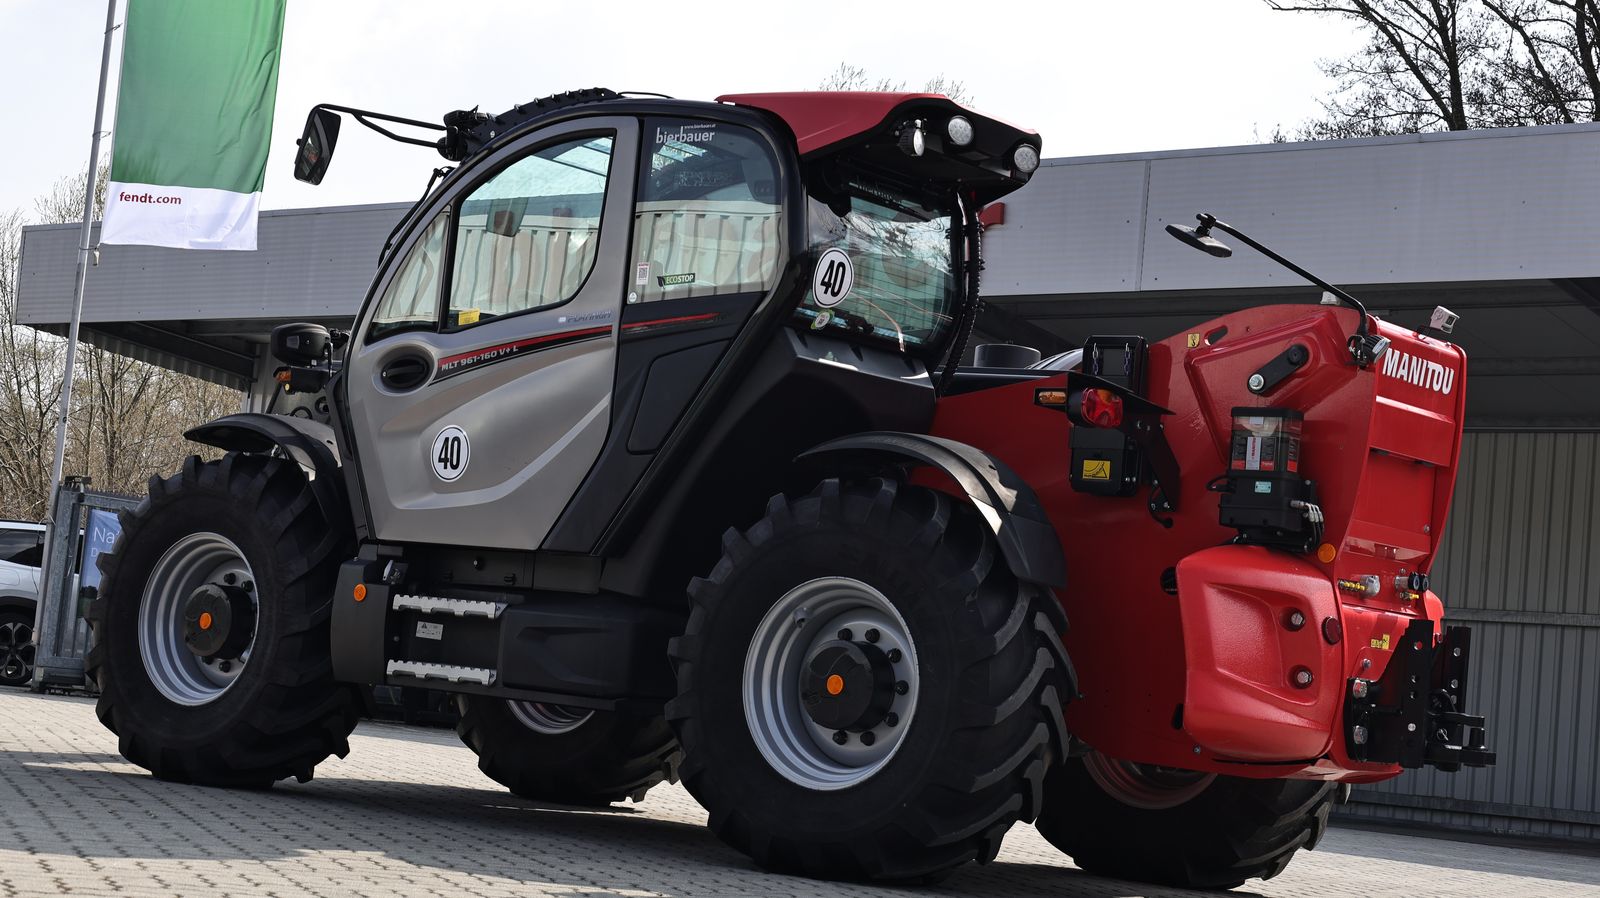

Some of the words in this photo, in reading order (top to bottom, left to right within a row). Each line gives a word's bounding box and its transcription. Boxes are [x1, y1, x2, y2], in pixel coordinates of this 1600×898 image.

[656, 126, 715, 143] bierbauer
[120, 192, 182, 204] fendt.com
[666, 274, 694, 284] ECOSTOP
[820, 259, 846, 297] 40
[441, 361, 460, 371] MLT
[461, 351, 497, 366] 961-160
[1382, 347, 1455, 395] MANITOU
[438, 436, 461, 470] 40
